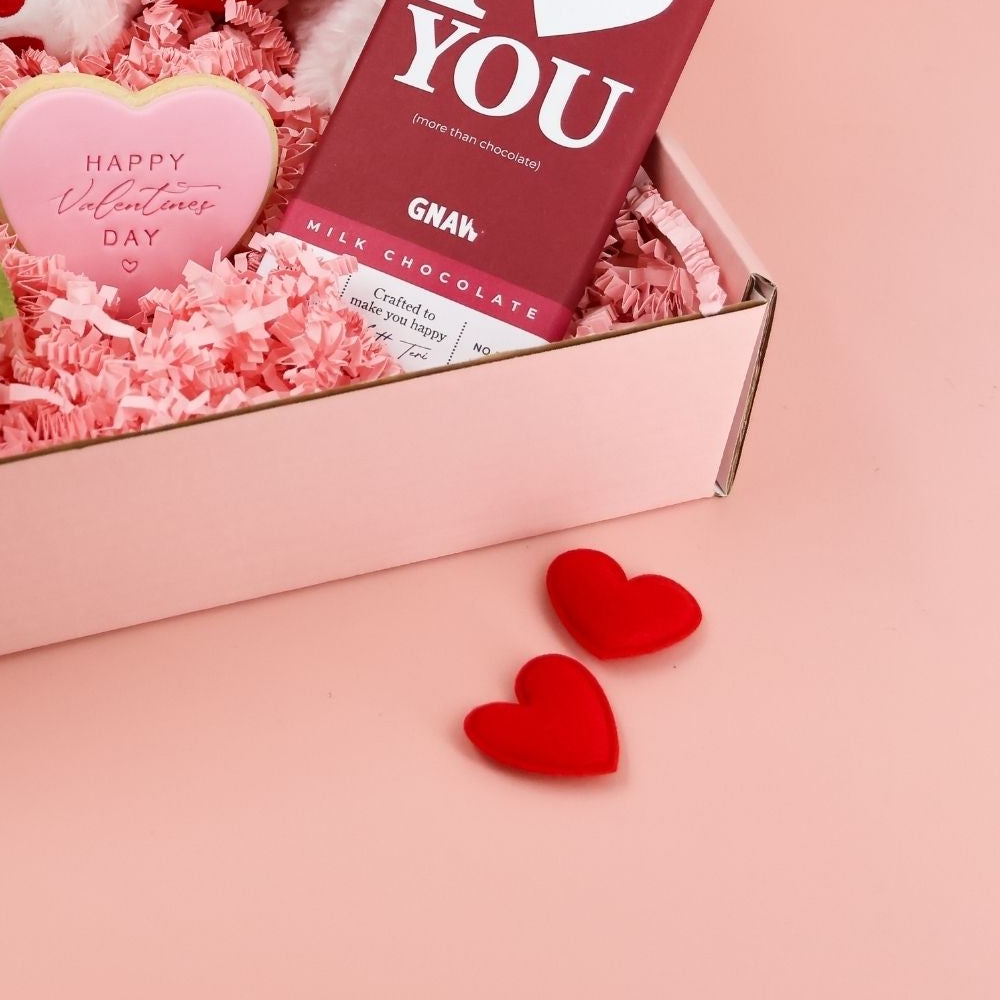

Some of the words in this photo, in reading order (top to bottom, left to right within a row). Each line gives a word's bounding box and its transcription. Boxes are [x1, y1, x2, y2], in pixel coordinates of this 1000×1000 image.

[393, 3, 635, 149] YOU
[86, 153, 185, 171] HAPPY
[412, 113, 449, 133] (more
[449, 127, 478, 145] than
[479, 138, 542, 172] chocolate)
[53, 178, 221, 220] Valentines
[104, 229, 160, 246] DAY
[306, 219, 367, 251] MILK
[383, 250, 538, 319] CHOCOLATE
[350, 296, 383, 316] make
[384, 311, 408, 326] you
[412, 320, 448, 343] happy
[373, 287, 422, 315] Crafted
[423, 307, 436, 321] to
